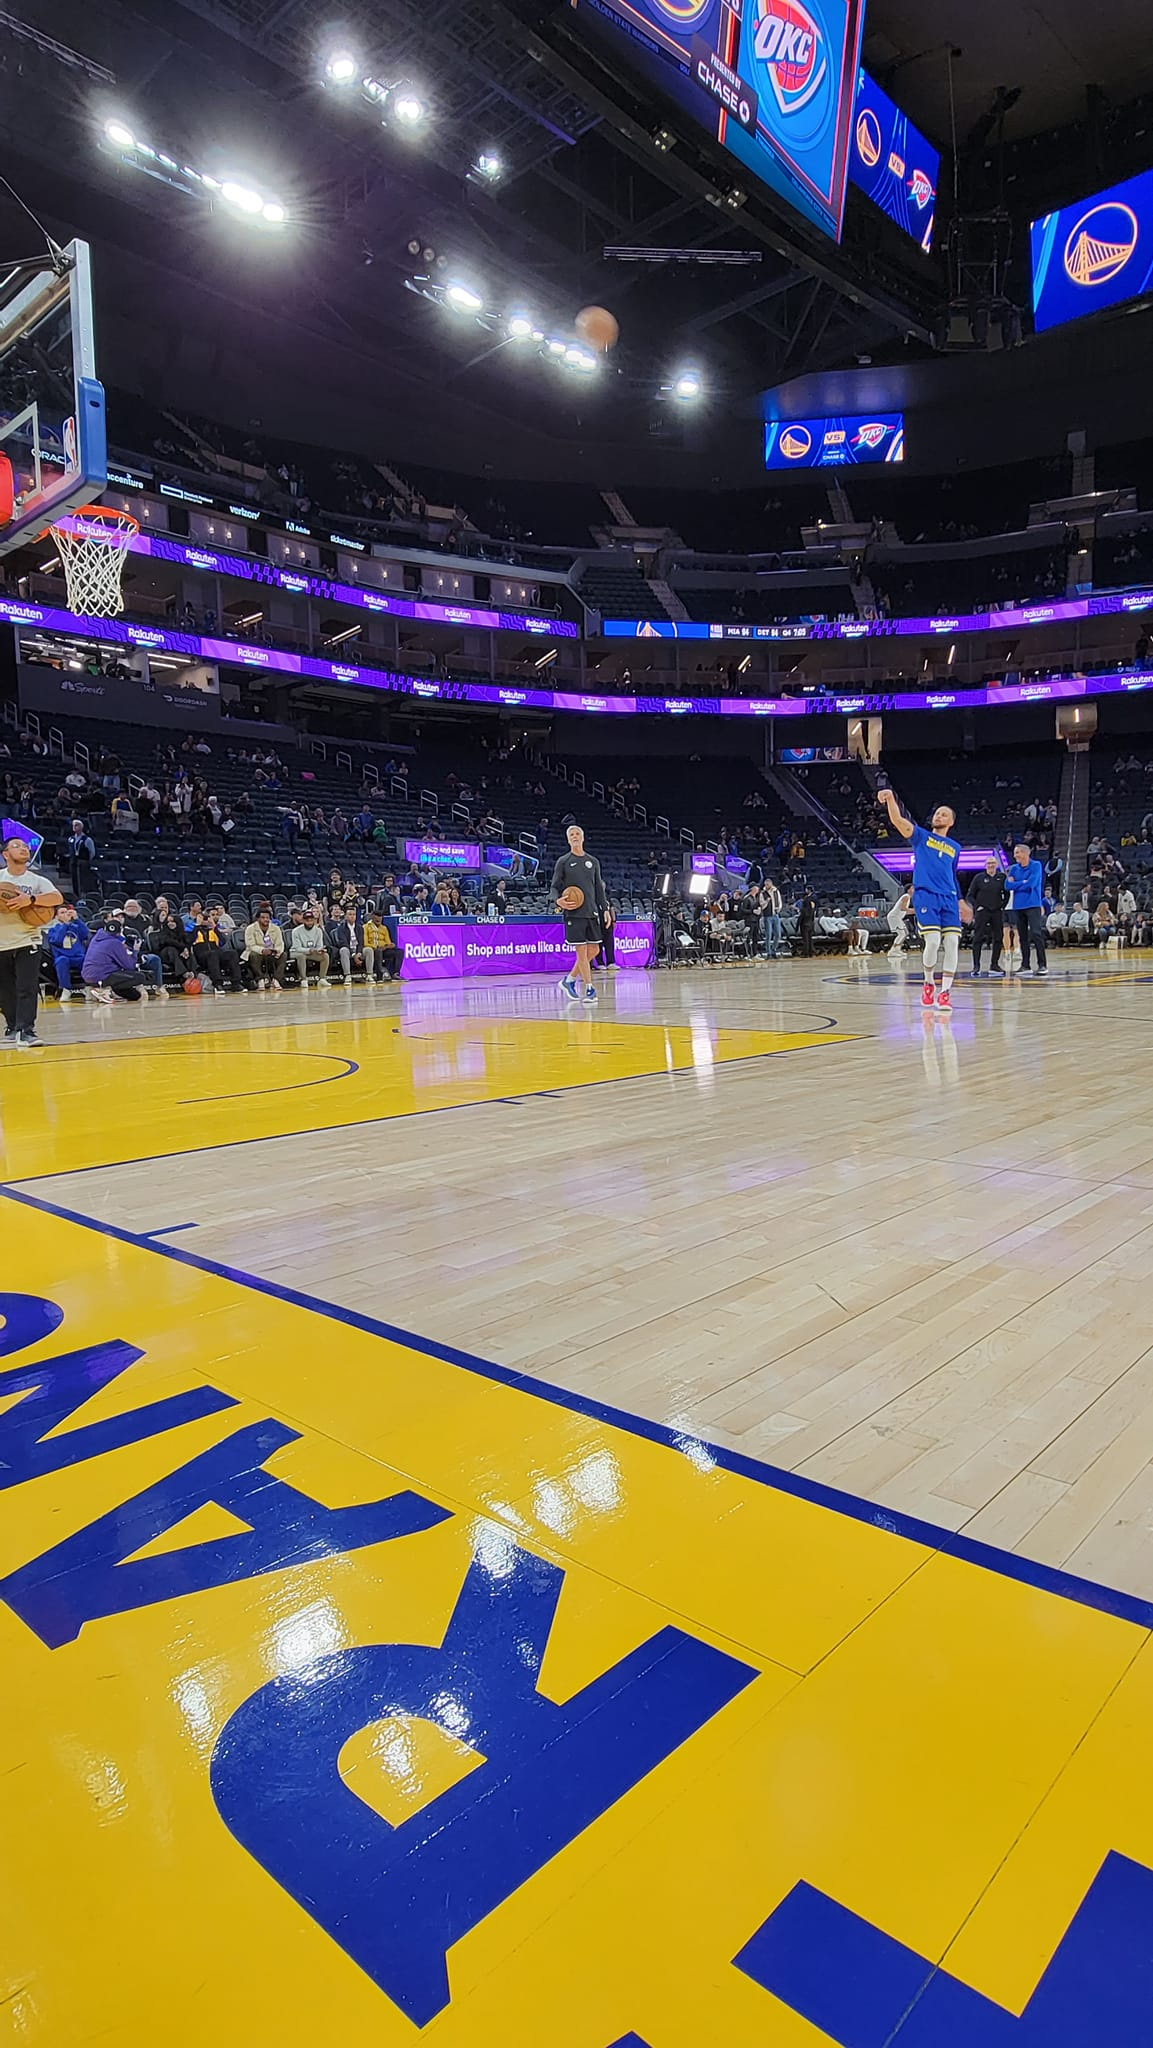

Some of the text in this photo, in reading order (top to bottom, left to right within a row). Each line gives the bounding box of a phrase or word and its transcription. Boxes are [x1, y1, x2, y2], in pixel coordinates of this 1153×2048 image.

[755, 16, 812, 64] OKC
[698, 60, 738, 113] CHASE
[229, 505, 258, 520] verizon
[77, 523, 113, 538] Rakuten
[186, 549, 218, 566] Rakuten
[280, 573, 308, 588] Rakuten
[363, 594, 389, 608] Rakuten
[0, 603, 44, 621] Rakuten
[444, 608, 471, 620] Rakuten
[1023, 608, 1054, 618] Rakuten
[526, 620, 551, 630] Rakuten
[840, 624, 869, 634] Rakuten
[930, 619, 959, 628] Rakuten
[128, 627, 165, 644] Rakuten
[238, 648, 268, 662] Rakuten
[331, 664, 359, 678] Rakuten
[413, 680, 440, 694] Rakuten
[1121, 676, 1153, 686] Rakuten
[499, 690, 526, 701] Rakuten
[1020, 685, 1051, 696] Rakuten
[581, 697, 606, 708] Rakuten
[664, 700, 693, 710] Rakuten
[836, 698, 865, 708] Rakuten
[926, 694, 956, 704] Rakuten
[750, 702, 776, 711] Rakuten
[398, 916, 422, 924] CHASE
[476, 916, 498, 924] CHASE
[466, 943, 494, 958] Shop
[494, 942, 513, 954] and
[515, 943, 536, 954] save
[538, 941, 554, 953] like
[555, 944, 561, 952] a
[614, 936, 650, 950] Rakuten
[405, 942, 456, 958] Rakuten
